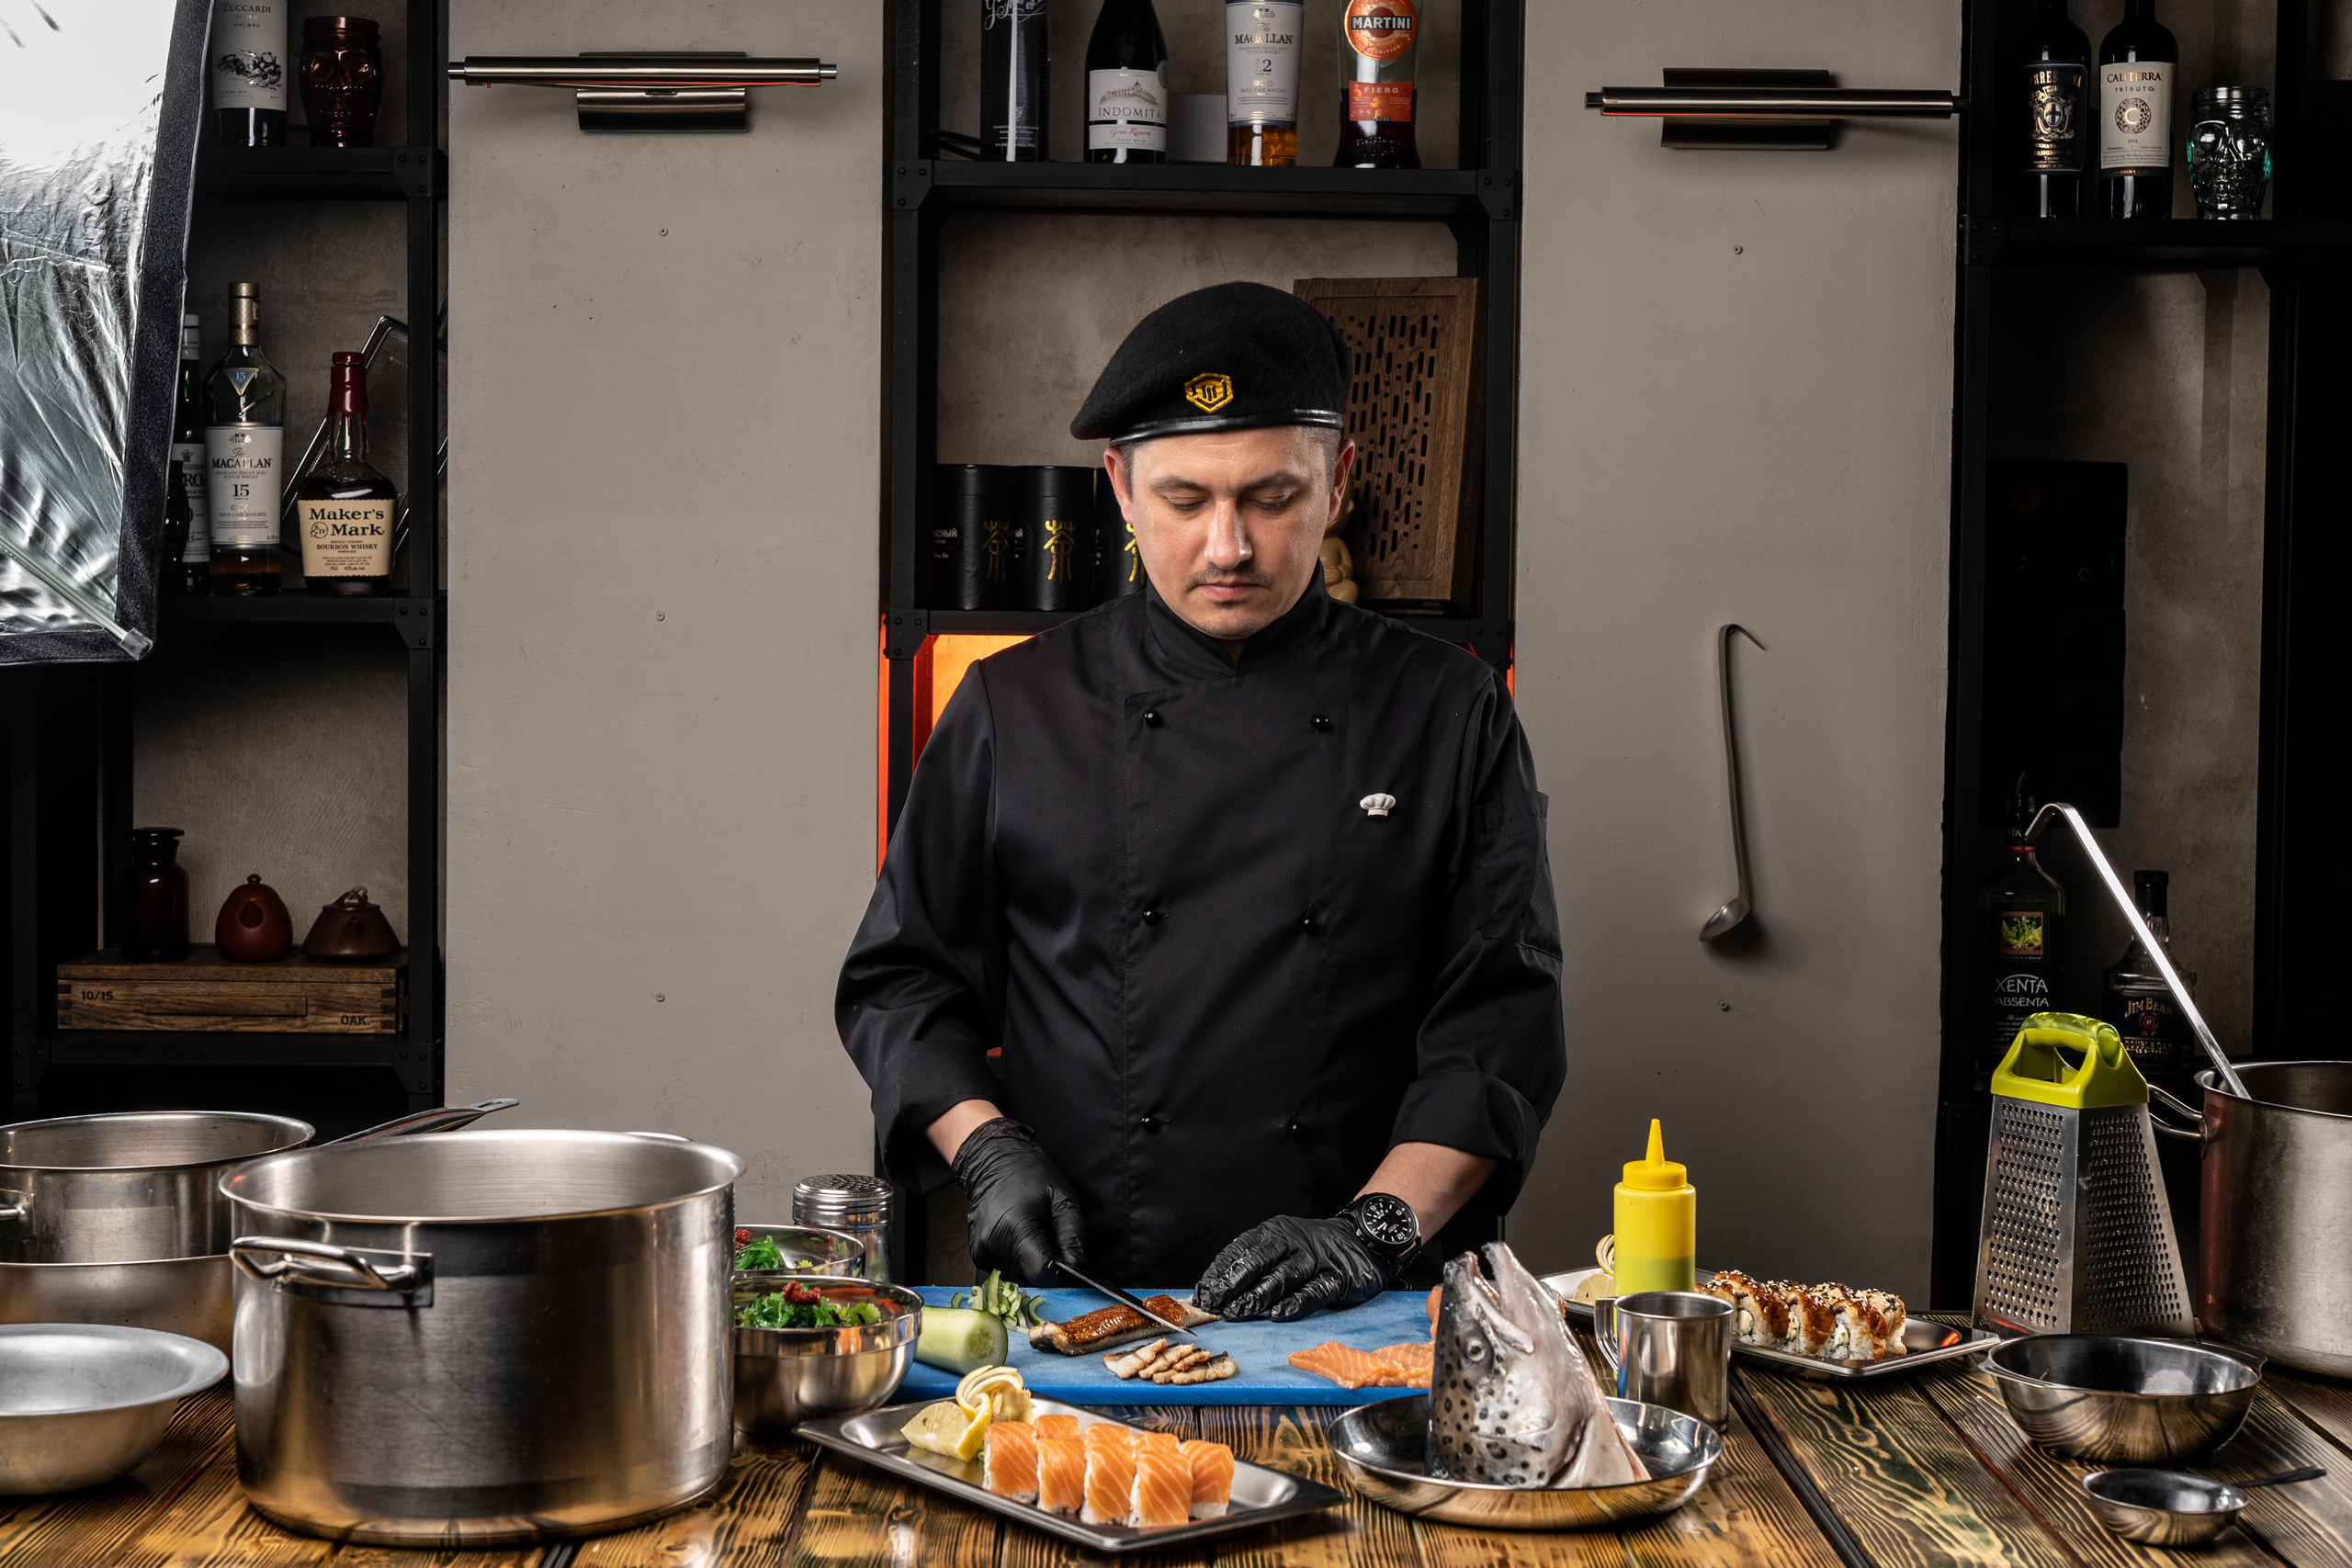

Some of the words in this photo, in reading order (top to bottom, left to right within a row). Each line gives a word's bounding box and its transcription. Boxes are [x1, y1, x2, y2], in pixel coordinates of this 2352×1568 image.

[222, 2, 272, 13] ZUCCARDI
[1352, 17, 1411, 29] MARTINI
[1234, 33, 1293, 44] MACALLAN
[1255, 59, 1272, 73] 12
[2107, 72, 2162, 83] CALITERRA
[1098, 107, 1161, 119] INDOMITA
[236, 371, 246, 380] 15
[211, 457, 274, 468] MACALLAN
[232, 483, 251, 498] 15
[309, 508, 384, 520] Maker's
[330, 524, 384, 536] Mark
[1995, 974, 2049, 994] XENTA
[82, 990, 114, 1001] 10/15
[1994, 997, 2050, 1008] ABSENTA
[2124, 999, 2144, 1019] JIM
[2145, 997, 2175, 1019] BEAM
[2125, 1040, 2155, 1050] DOUBLE
